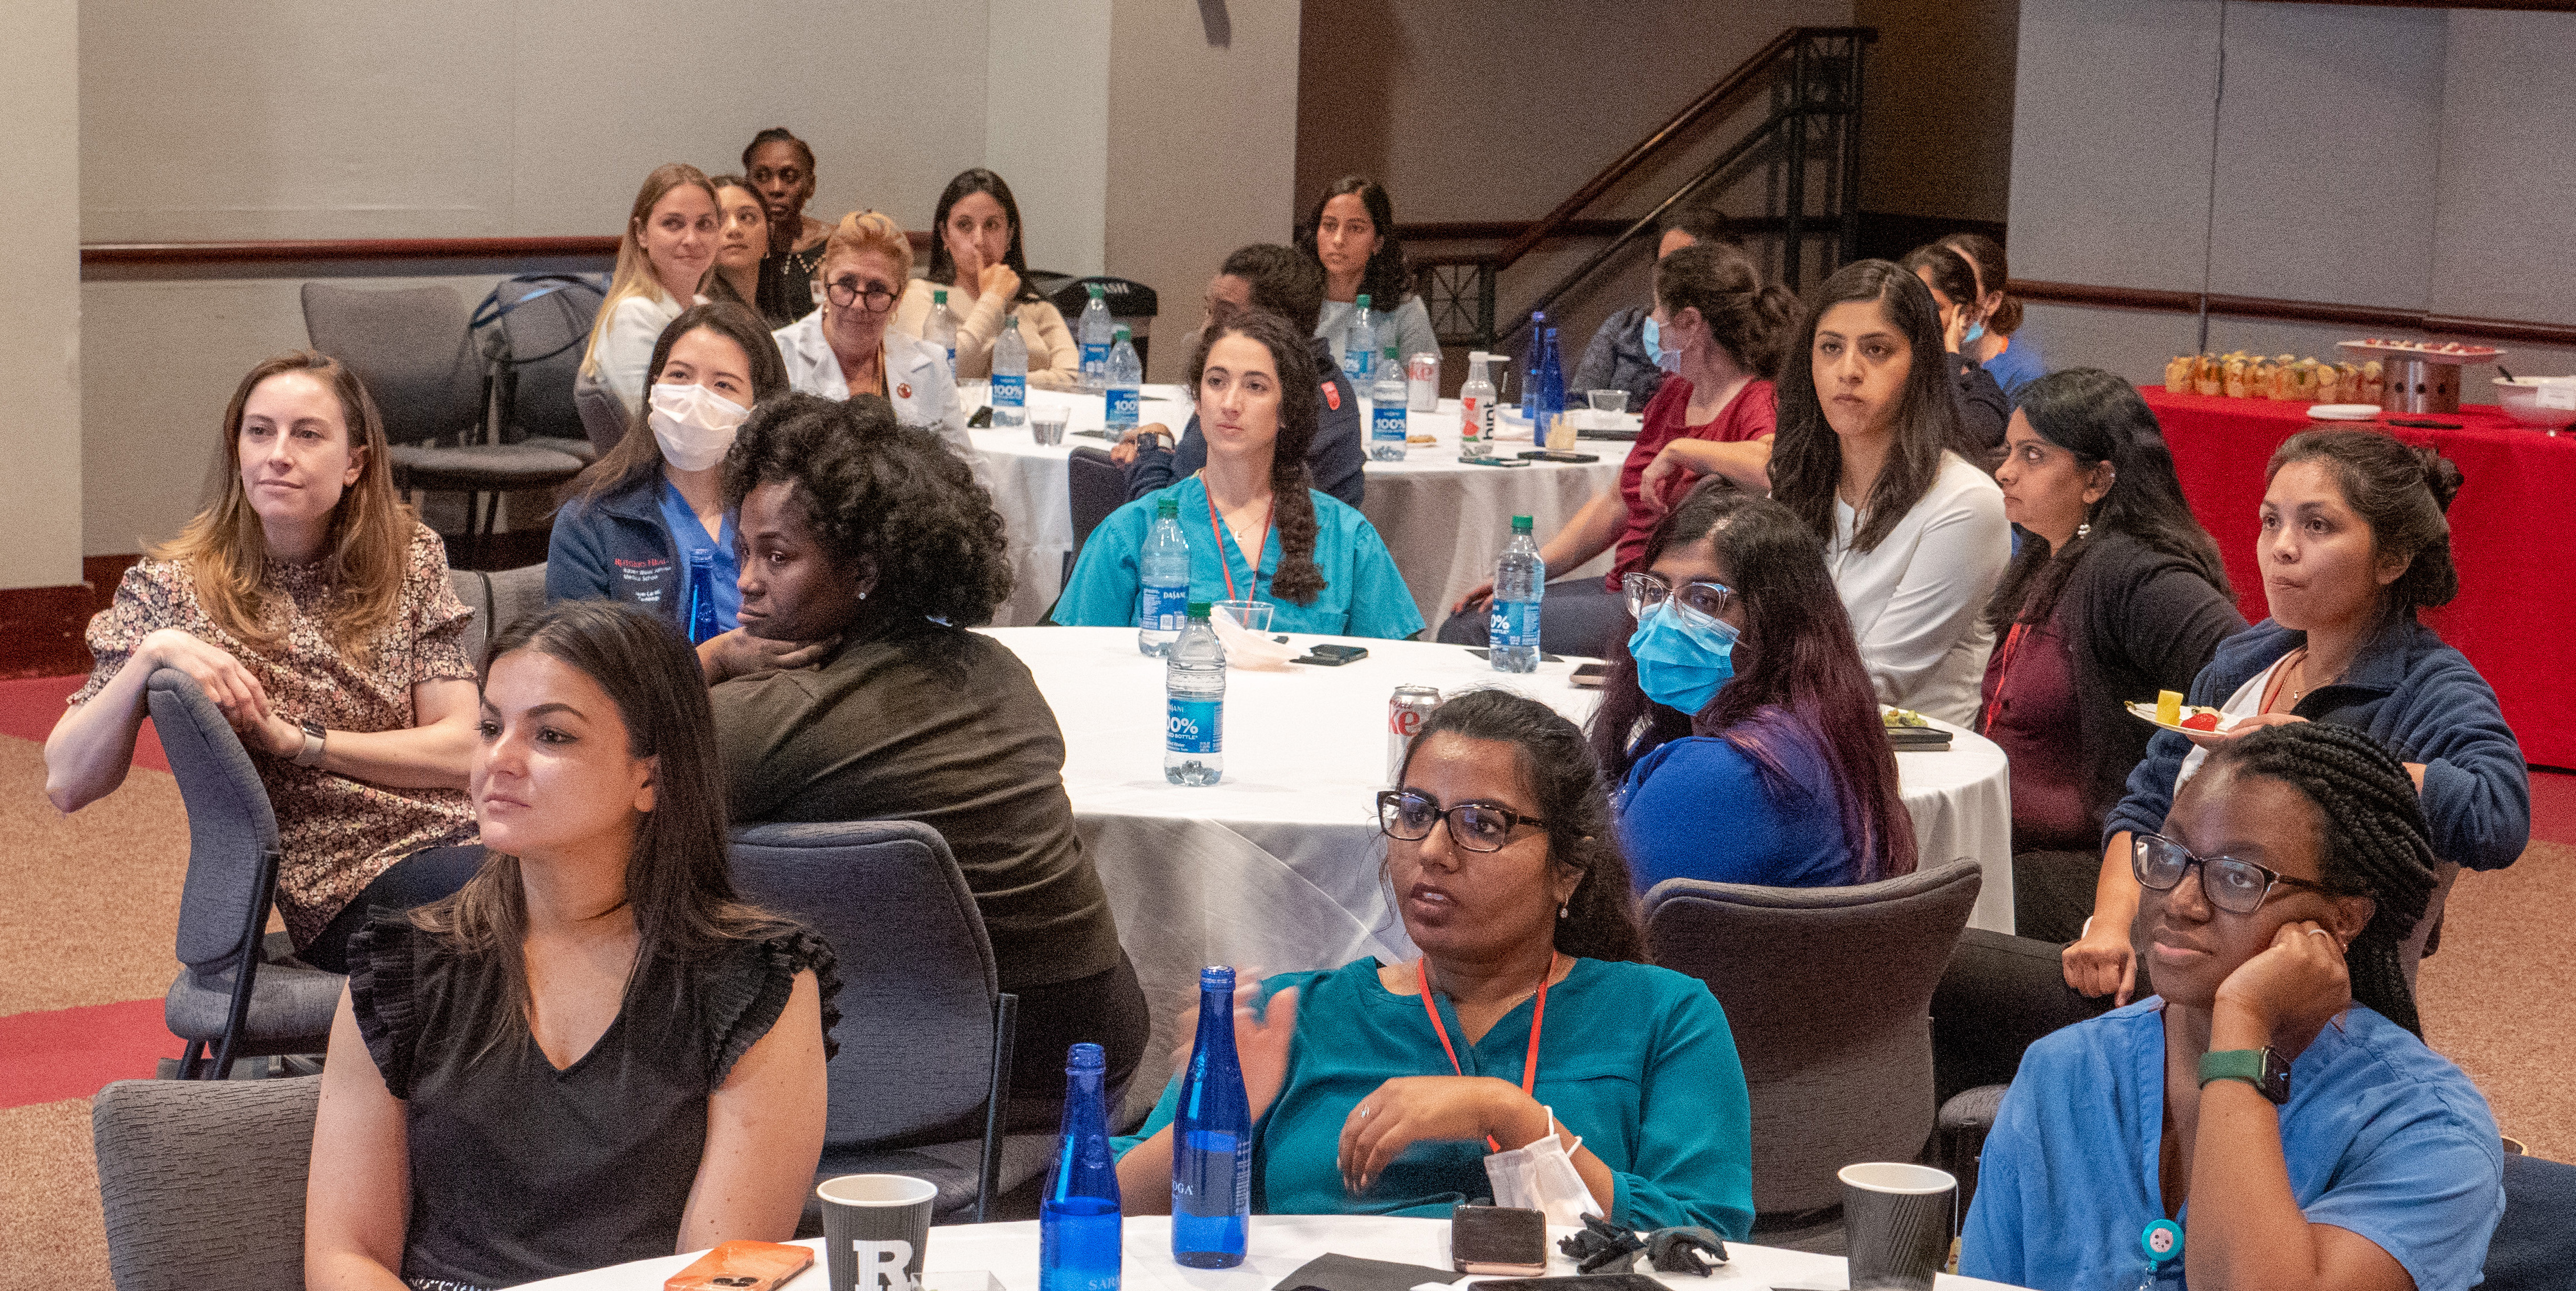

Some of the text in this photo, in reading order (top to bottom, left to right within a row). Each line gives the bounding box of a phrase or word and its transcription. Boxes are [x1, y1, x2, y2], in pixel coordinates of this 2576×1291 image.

[1081, 283, 1129, 294] TASH
[1114, 400, 1139, 411] 100
[1375, 418, 1405, 431] 100%
[1483, 402, 1494, 440] hint
[853, 1239, 919, 1291] R
